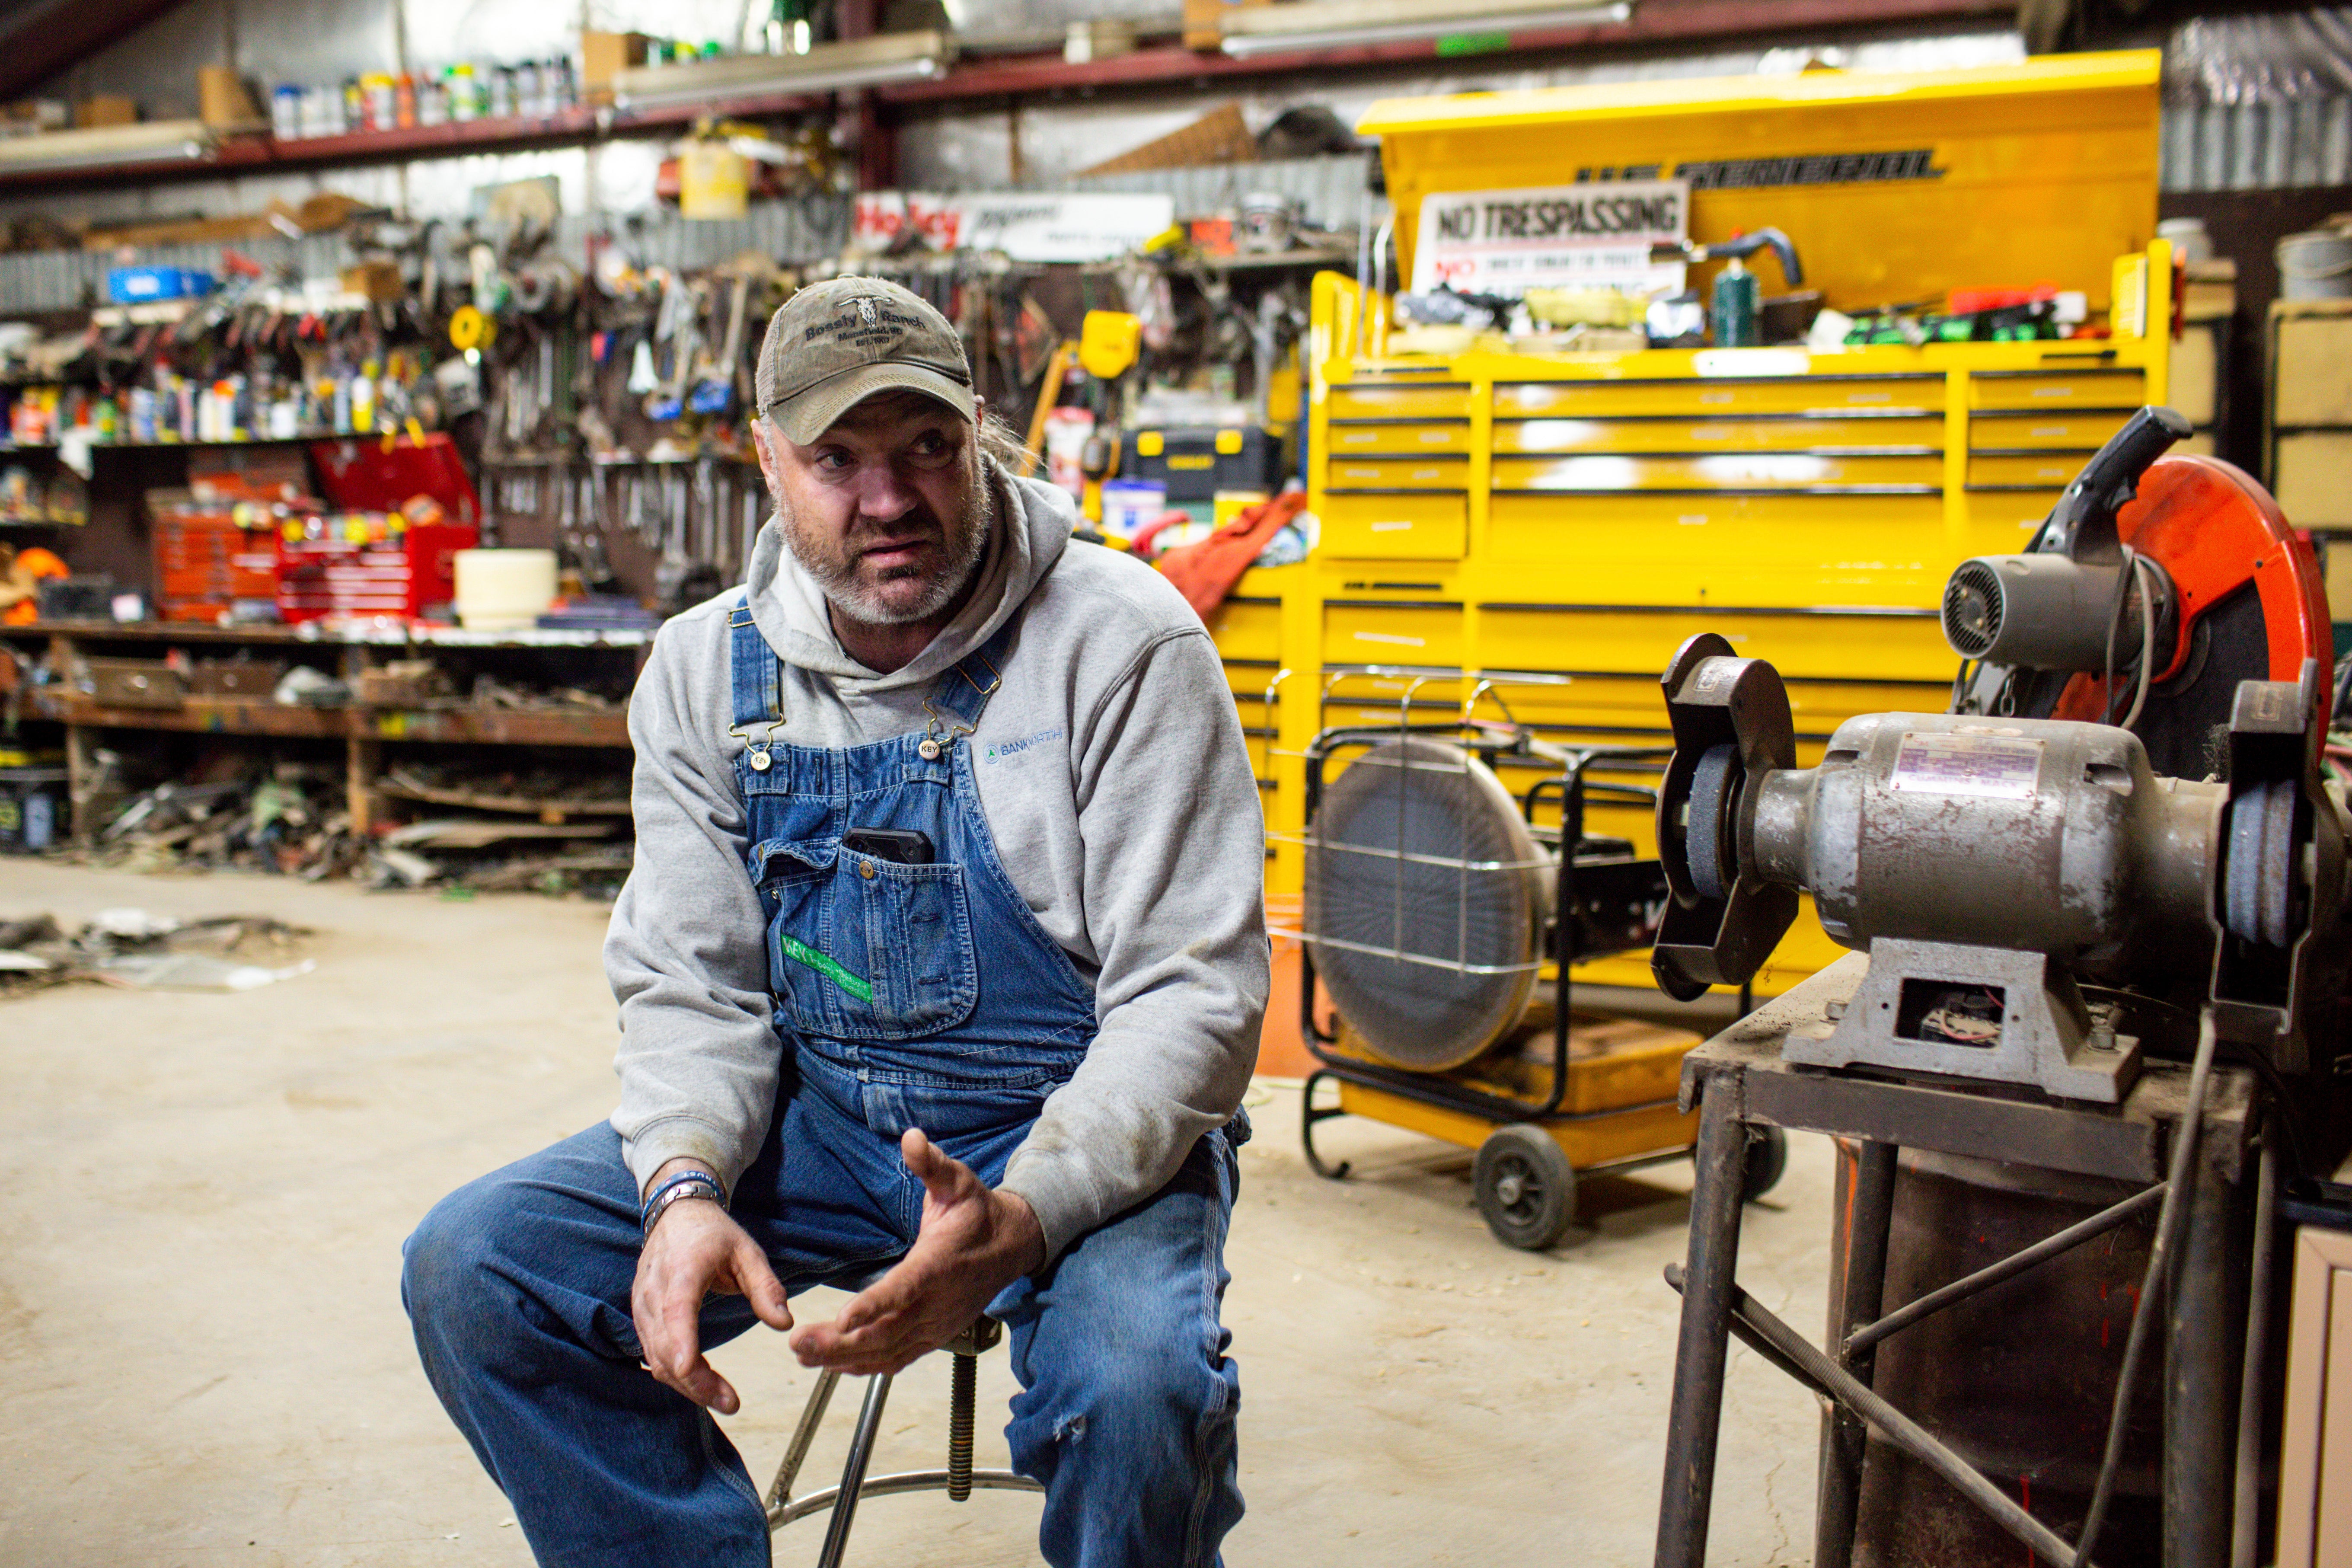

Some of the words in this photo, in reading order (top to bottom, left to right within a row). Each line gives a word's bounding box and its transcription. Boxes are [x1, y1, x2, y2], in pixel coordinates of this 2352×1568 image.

[1439, 207, 1476, 240] NO
[1485, 195, 1677, 238] TRESPASSING
[881, 310, 926, 329] Ranch
[1000, 728, 1063, 756] BANKNORTH
[754, 756, 768, 765] KEY
[783, 937, 807, 962] KEY
